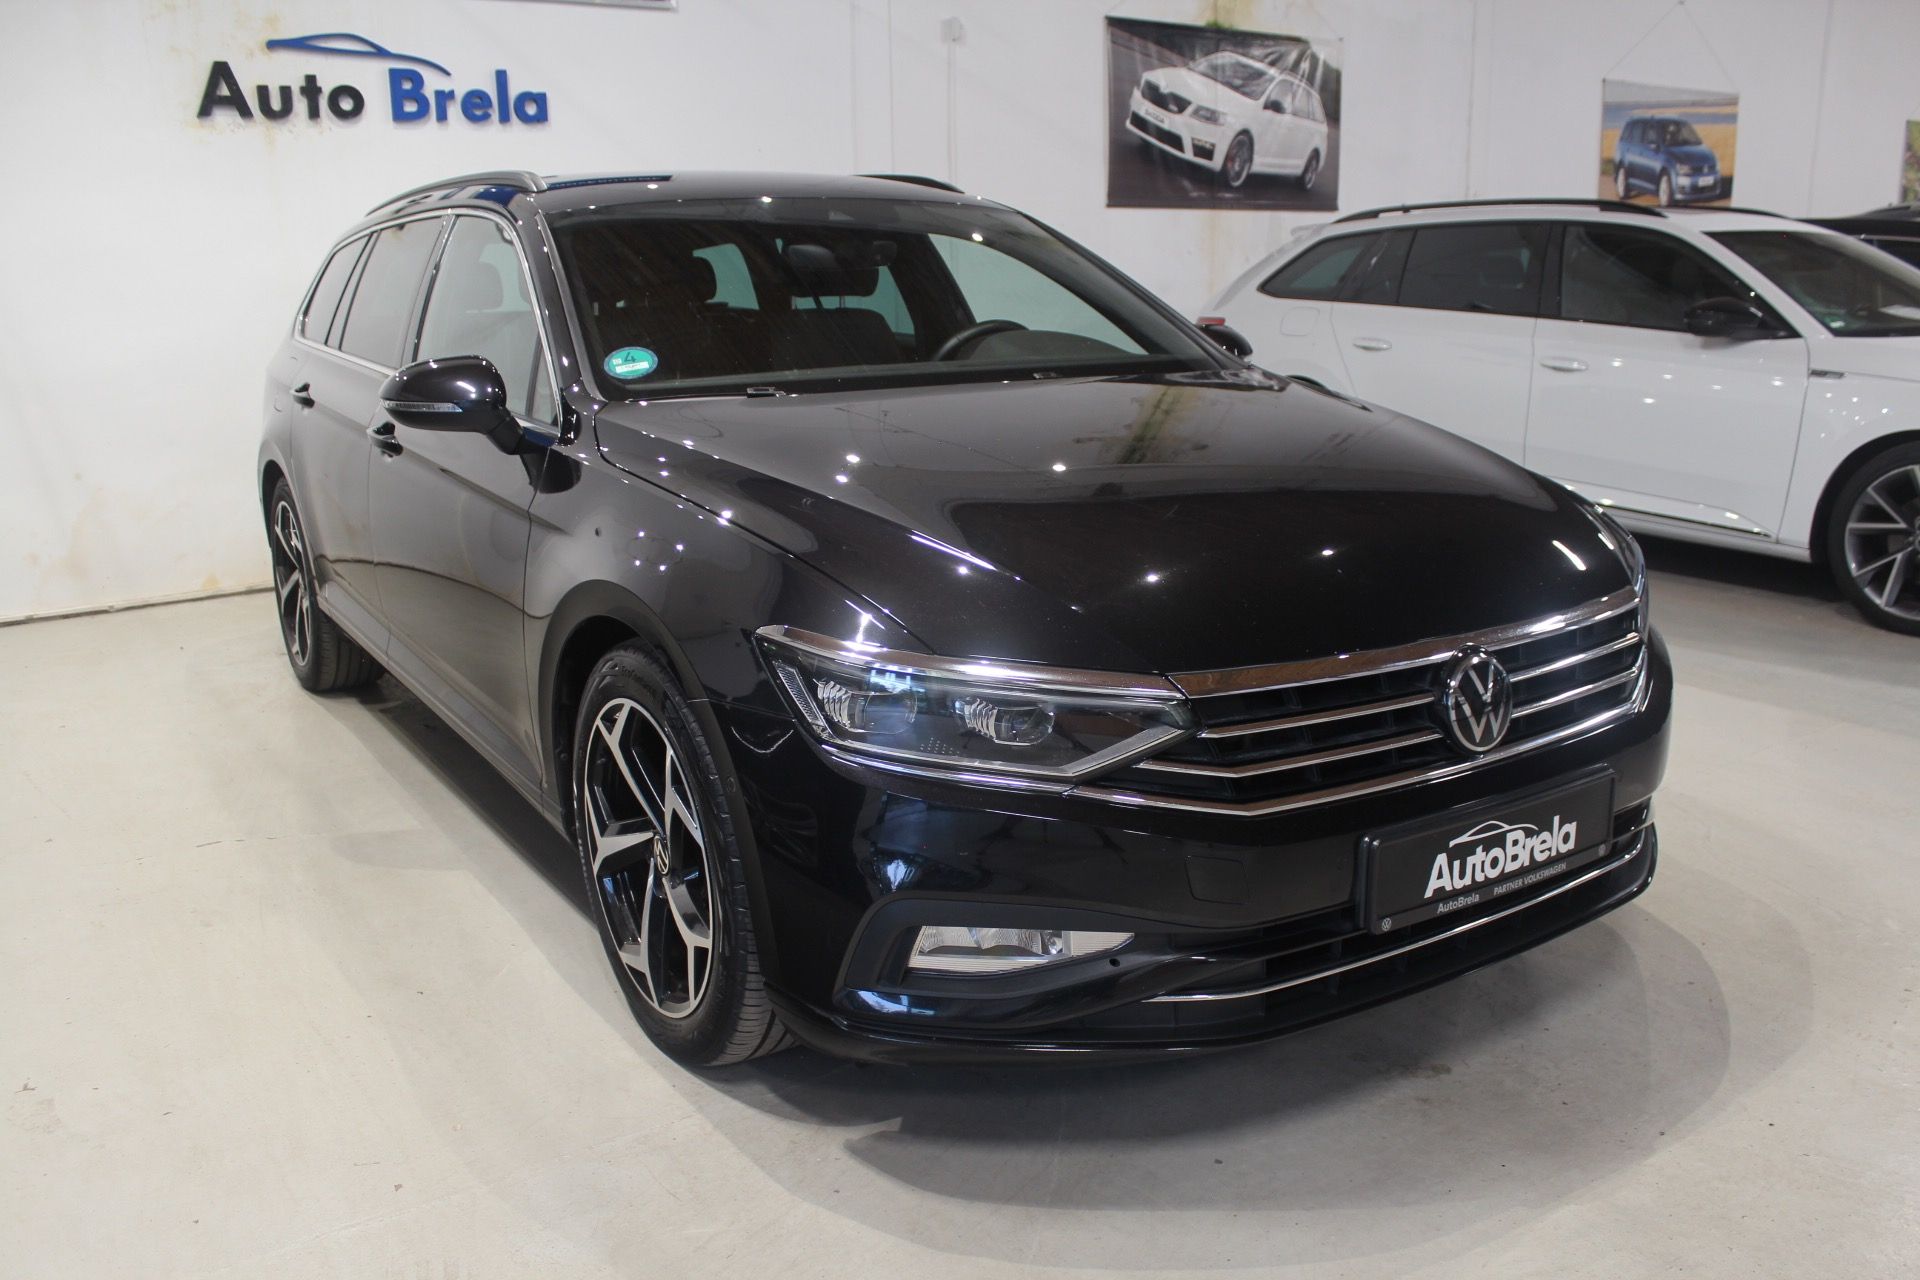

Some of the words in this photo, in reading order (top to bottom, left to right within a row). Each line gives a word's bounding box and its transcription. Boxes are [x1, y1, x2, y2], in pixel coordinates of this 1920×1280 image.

[198, 60, 365, 121] Auto
[388, 67, 549, 124] Brela
[624, 351, 637, 363] 4
[1424, 815, 1577, 898] AutoBrela
[1437, 893, 1480, 914] AutoBrela
[1493, 878, 1523, 895] PARTNER
[1524, 862, 1566, 886] VOLKSWAGEN
